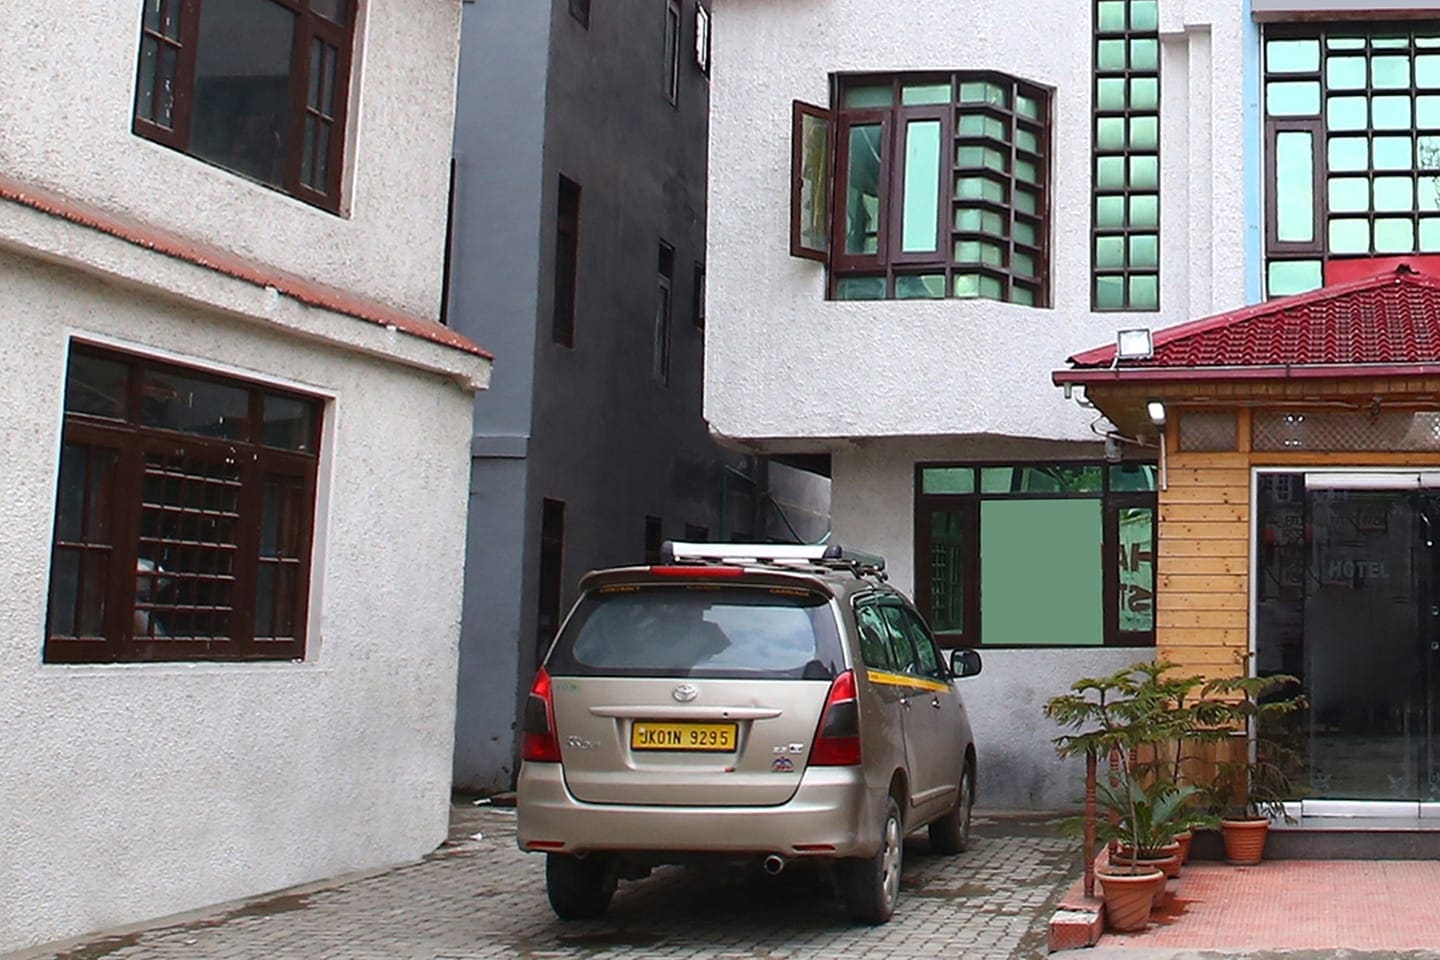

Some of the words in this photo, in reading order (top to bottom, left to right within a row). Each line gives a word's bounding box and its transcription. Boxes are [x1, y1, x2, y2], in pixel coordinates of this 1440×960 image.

[1329, 560, 1390, 577] HOTEL
[640, 730, 682, 744] JK01N
[690, 730, 729, 745] 9295
